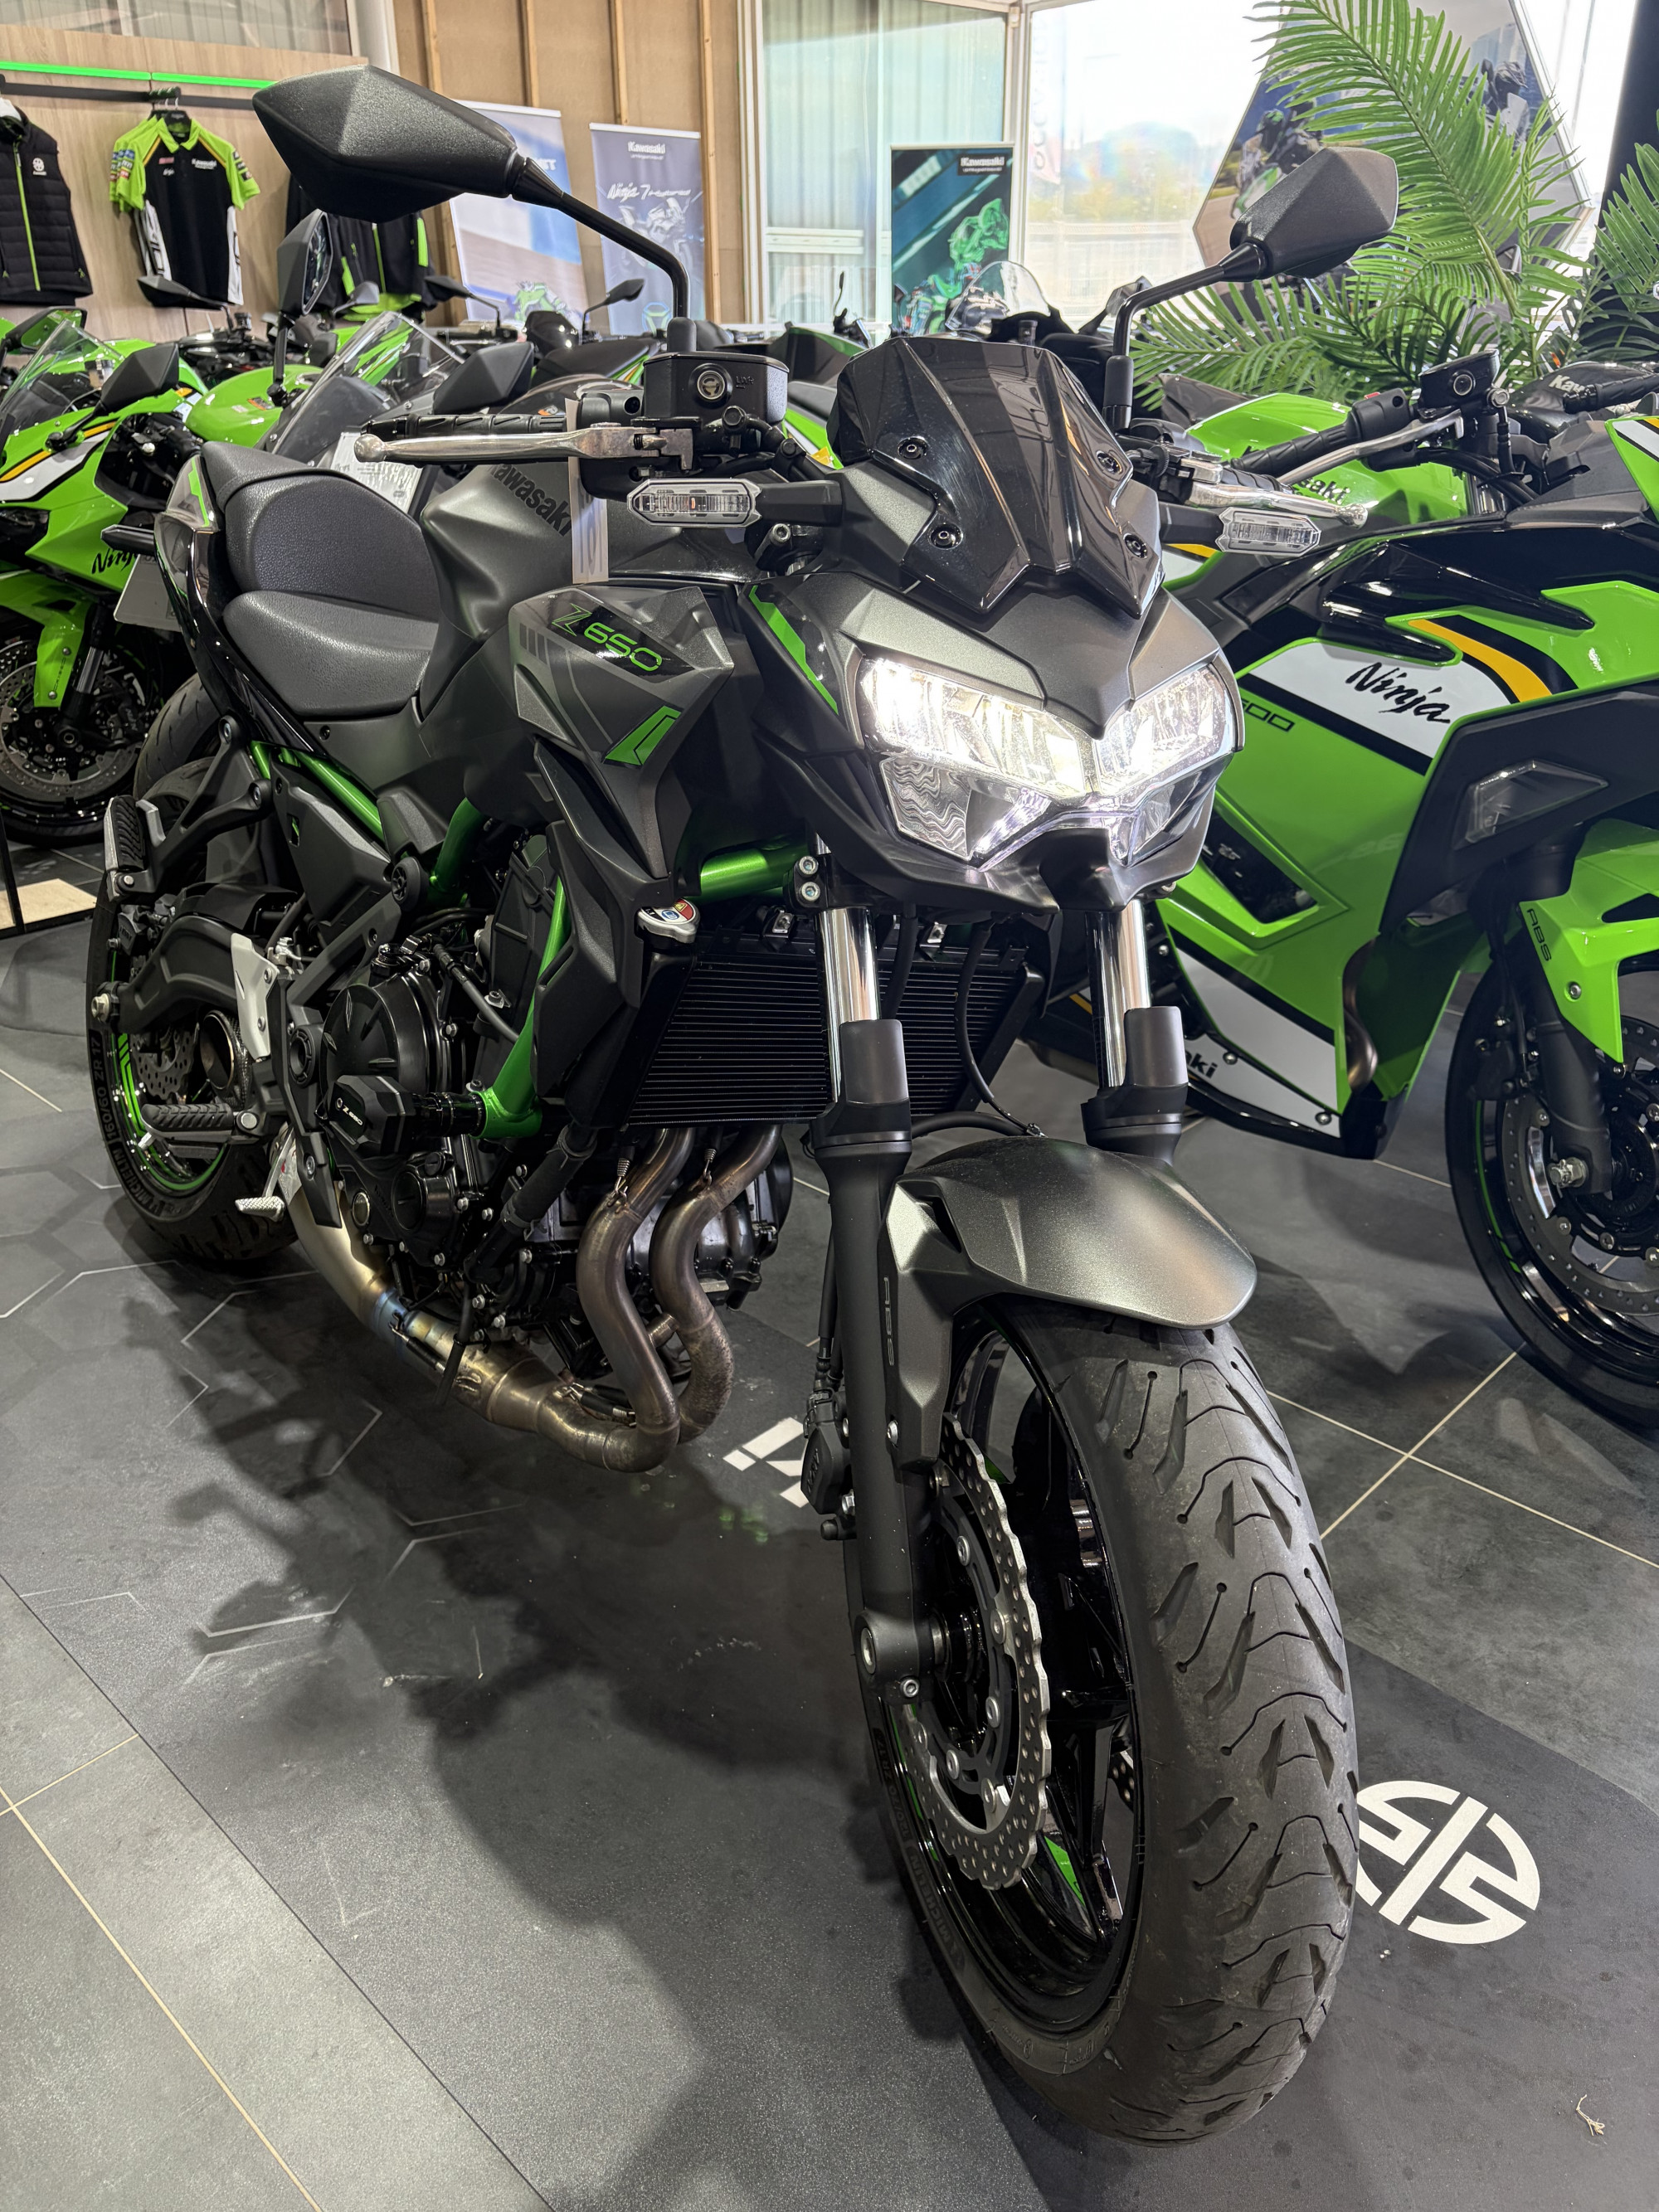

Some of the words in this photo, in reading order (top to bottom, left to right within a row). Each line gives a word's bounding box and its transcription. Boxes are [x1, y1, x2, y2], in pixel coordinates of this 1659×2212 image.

[488, 464, 572, 537] awasaki
[1241, 698, 1296, 732] 00
[1345, 662, 1451, 723] Ninja
[1527, 907, 1552, 961] ABS
[883, 1276, 894, 1366] ABS
